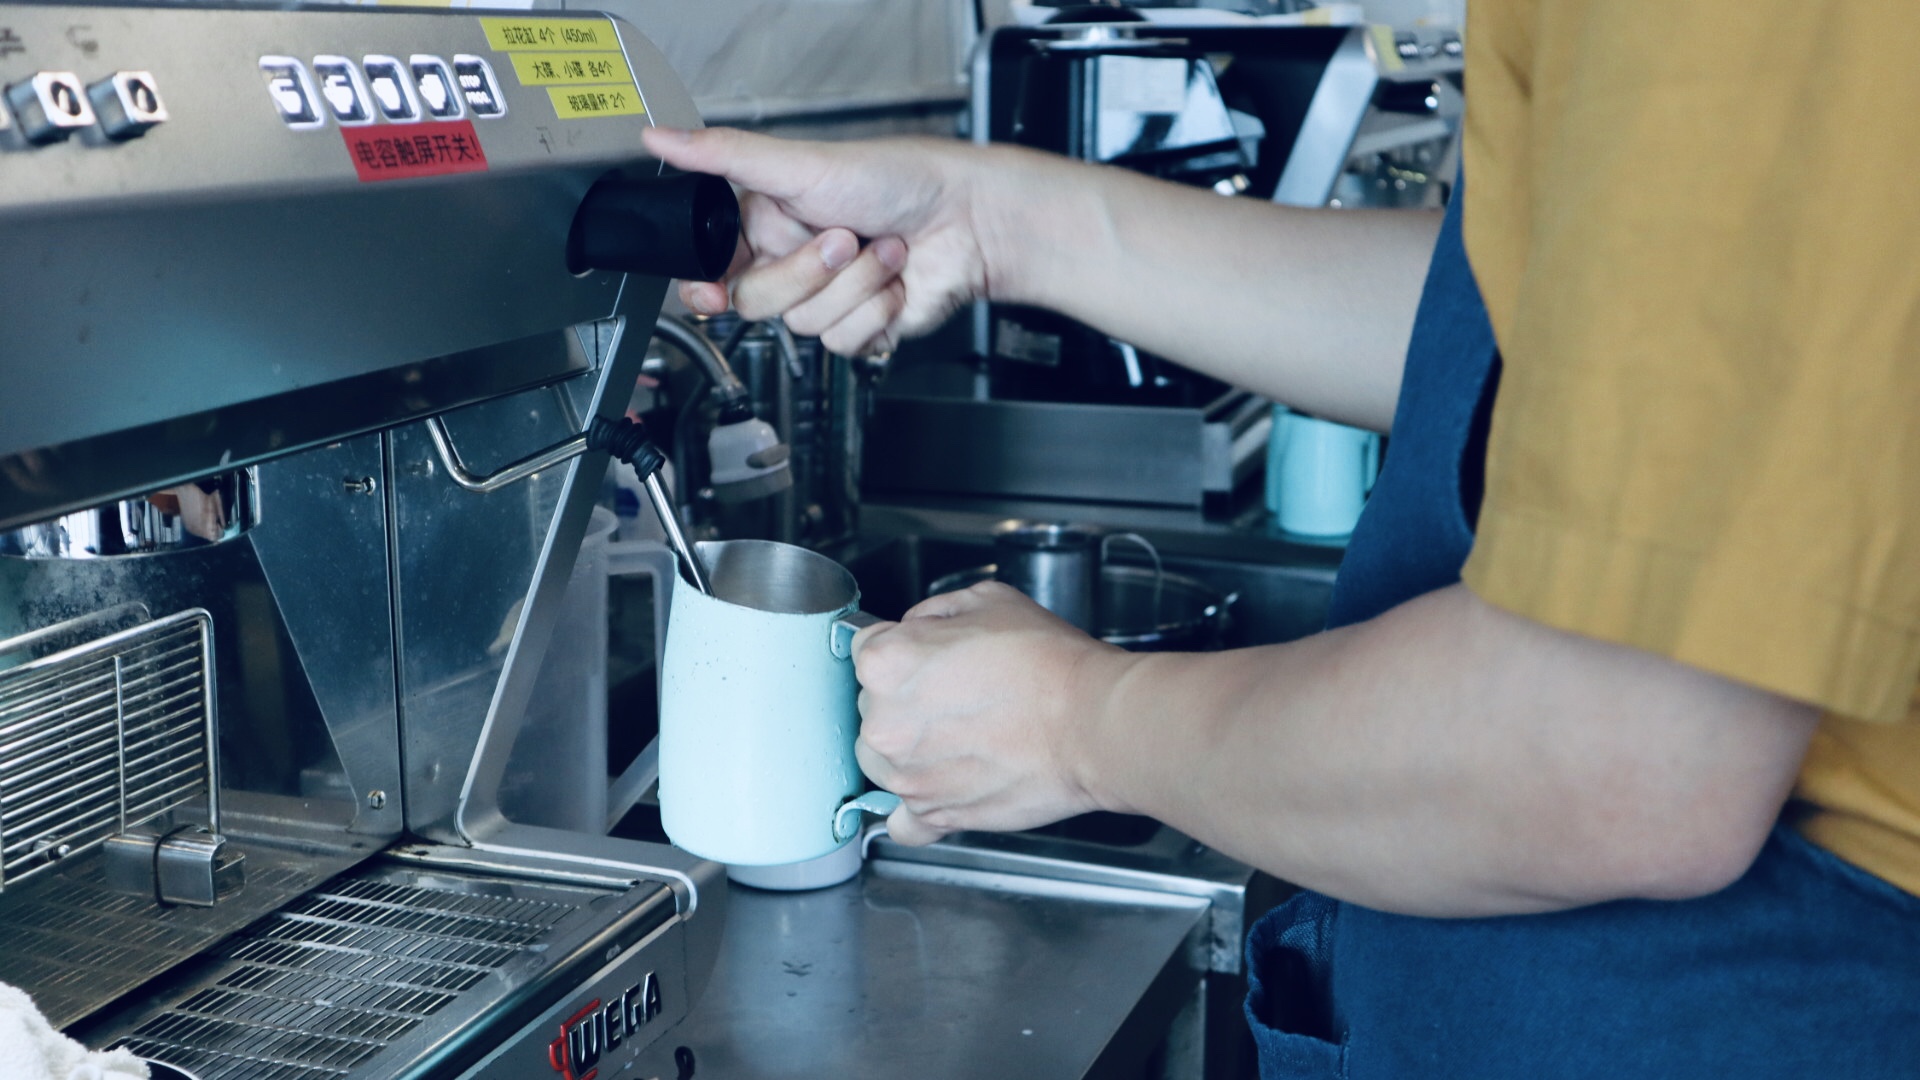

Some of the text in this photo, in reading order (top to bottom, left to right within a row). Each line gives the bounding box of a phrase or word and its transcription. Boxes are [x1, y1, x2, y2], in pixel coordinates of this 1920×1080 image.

[502, 27, 538, 45] 拉花缸
[539, 27, 555, 45] 4个
[588, 60, 612, 78] 各4个
[459, 75, 481, 88] STOP
[567, 92, 626, 112] 玻璃量杯 2个
[354, 133, 481, 170] 电容触屏开关!
[568, 970, 662, 1076] WEGA
